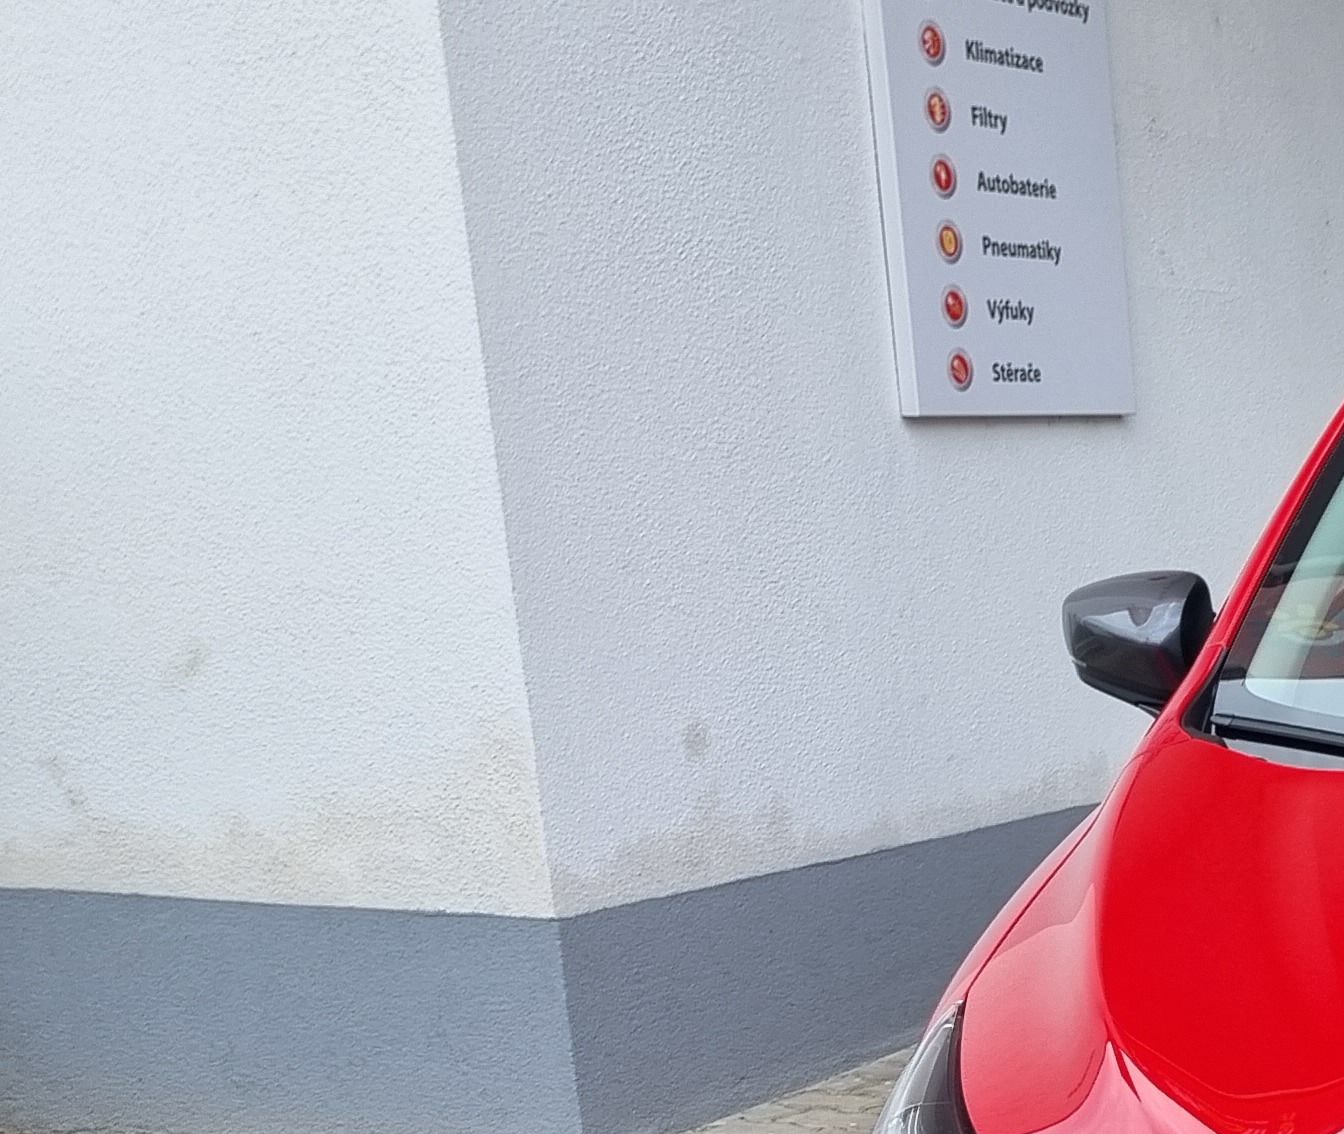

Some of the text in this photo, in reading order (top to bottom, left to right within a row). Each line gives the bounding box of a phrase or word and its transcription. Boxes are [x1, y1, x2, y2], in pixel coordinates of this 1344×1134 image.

[965, 40, 1044, 74] Klimatizace
[971, 106, 1008, 135] Filtry
[977, 171, 1057, 200] Autobaterie
[982, 236, 1061, 265] Pneumatiky
[987, 299, 1034, 326] Výfuky
[992, 363, 1041, 383] Stěrače
